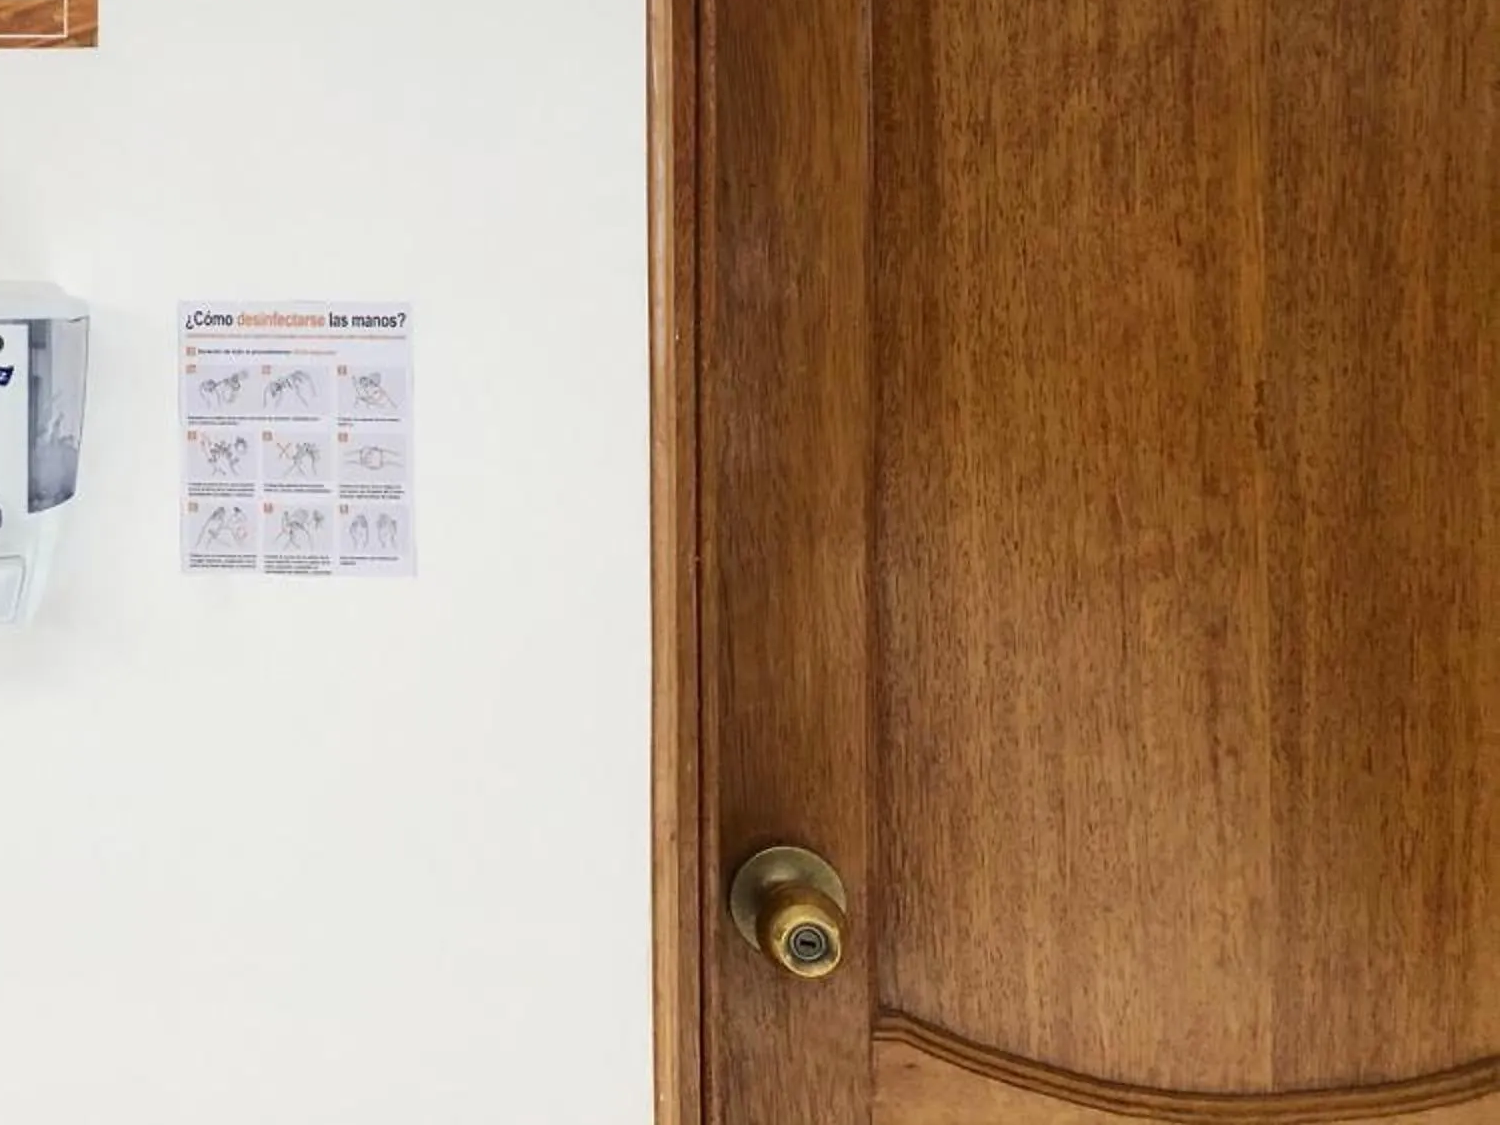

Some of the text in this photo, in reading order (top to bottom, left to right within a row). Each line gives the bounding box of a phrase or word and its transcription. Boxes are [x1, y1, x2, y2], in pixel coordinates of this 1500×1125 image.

[185, 310, 407, 330] ¿Cómo desinfectarse las manos?
